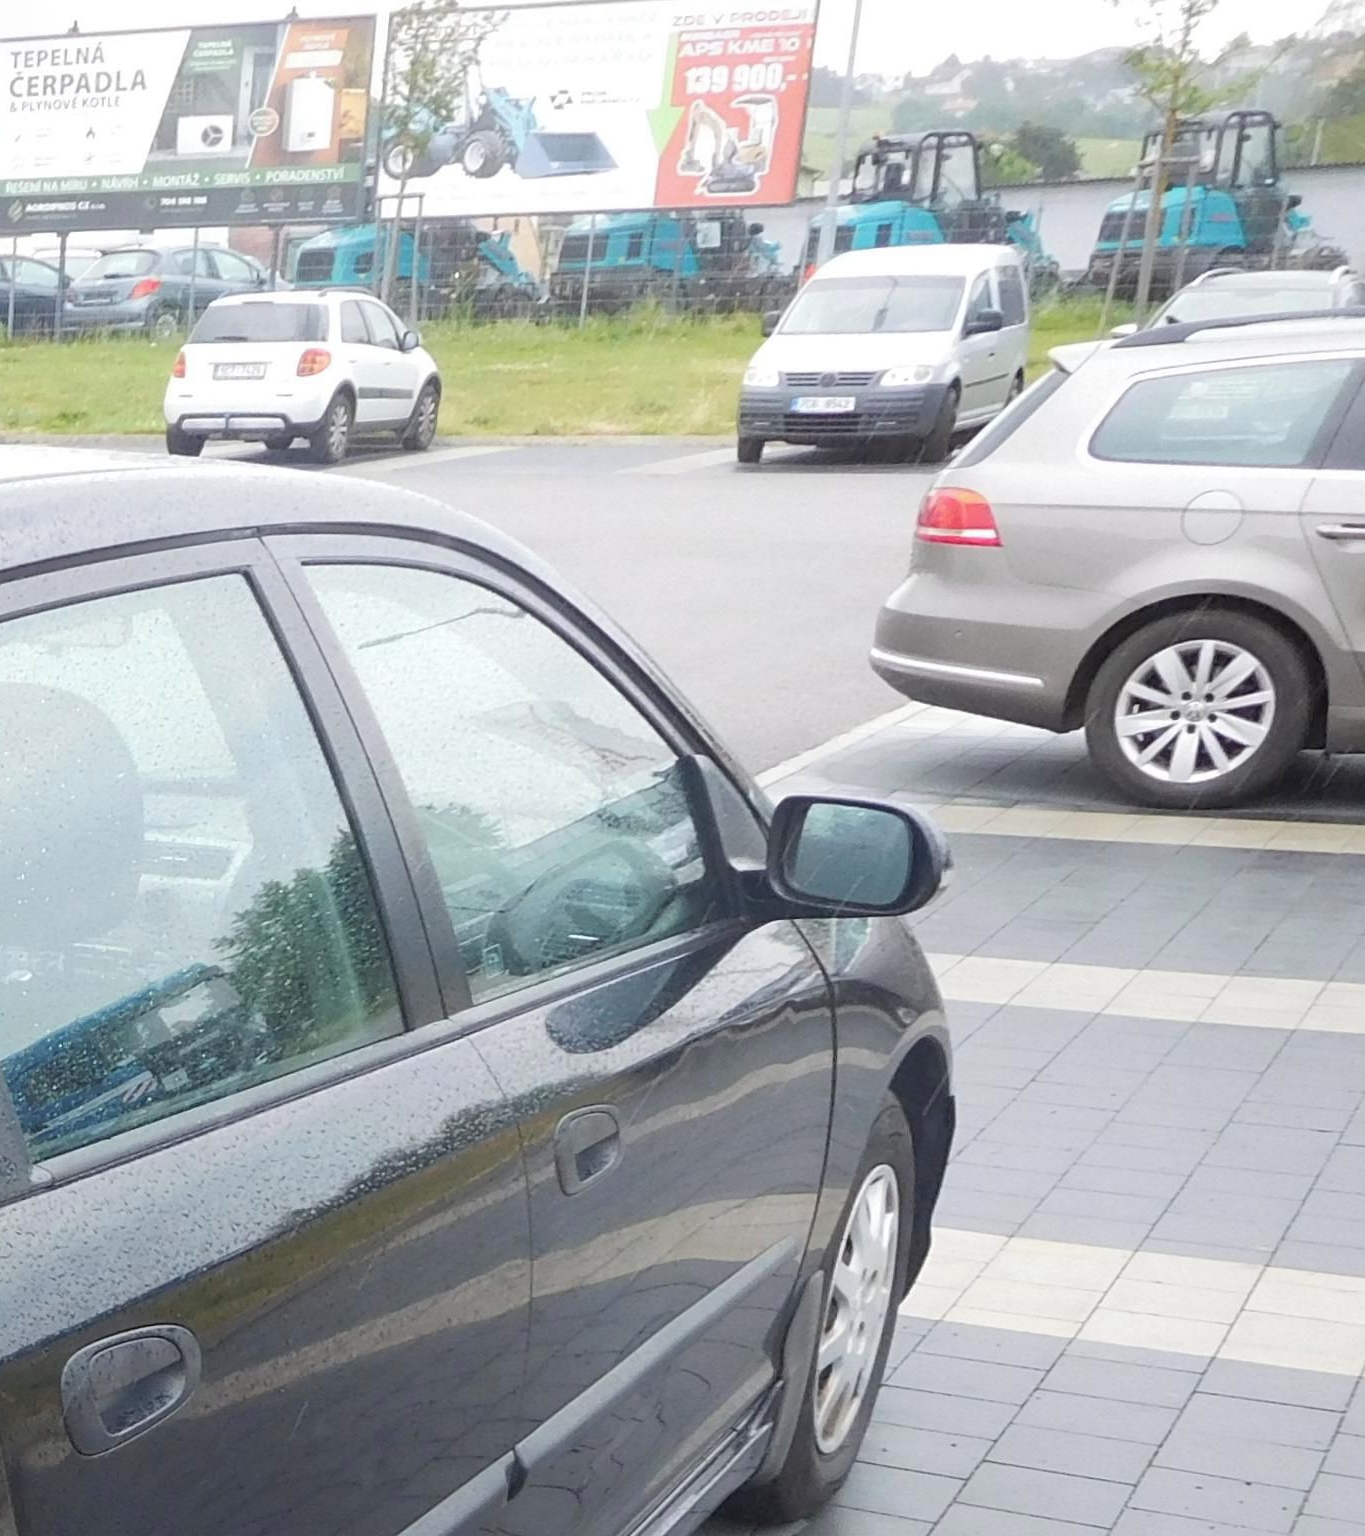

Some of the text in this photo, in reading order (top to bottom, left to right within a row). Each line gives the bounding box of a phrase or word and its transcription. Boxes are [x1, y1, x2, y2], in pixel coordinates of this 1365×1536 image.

[10, 41, 105, 69] TEPELNÁ
[9, 68, 148, 98] ČERPADLA
[685, 65, 729, 95] 139
[10, 95, 121, 113] & PLYNOVÉ KOTLE
[213, 171, 251, 186] SERVIS
[265, 166, 346, 183] PORADENSTVÍ
